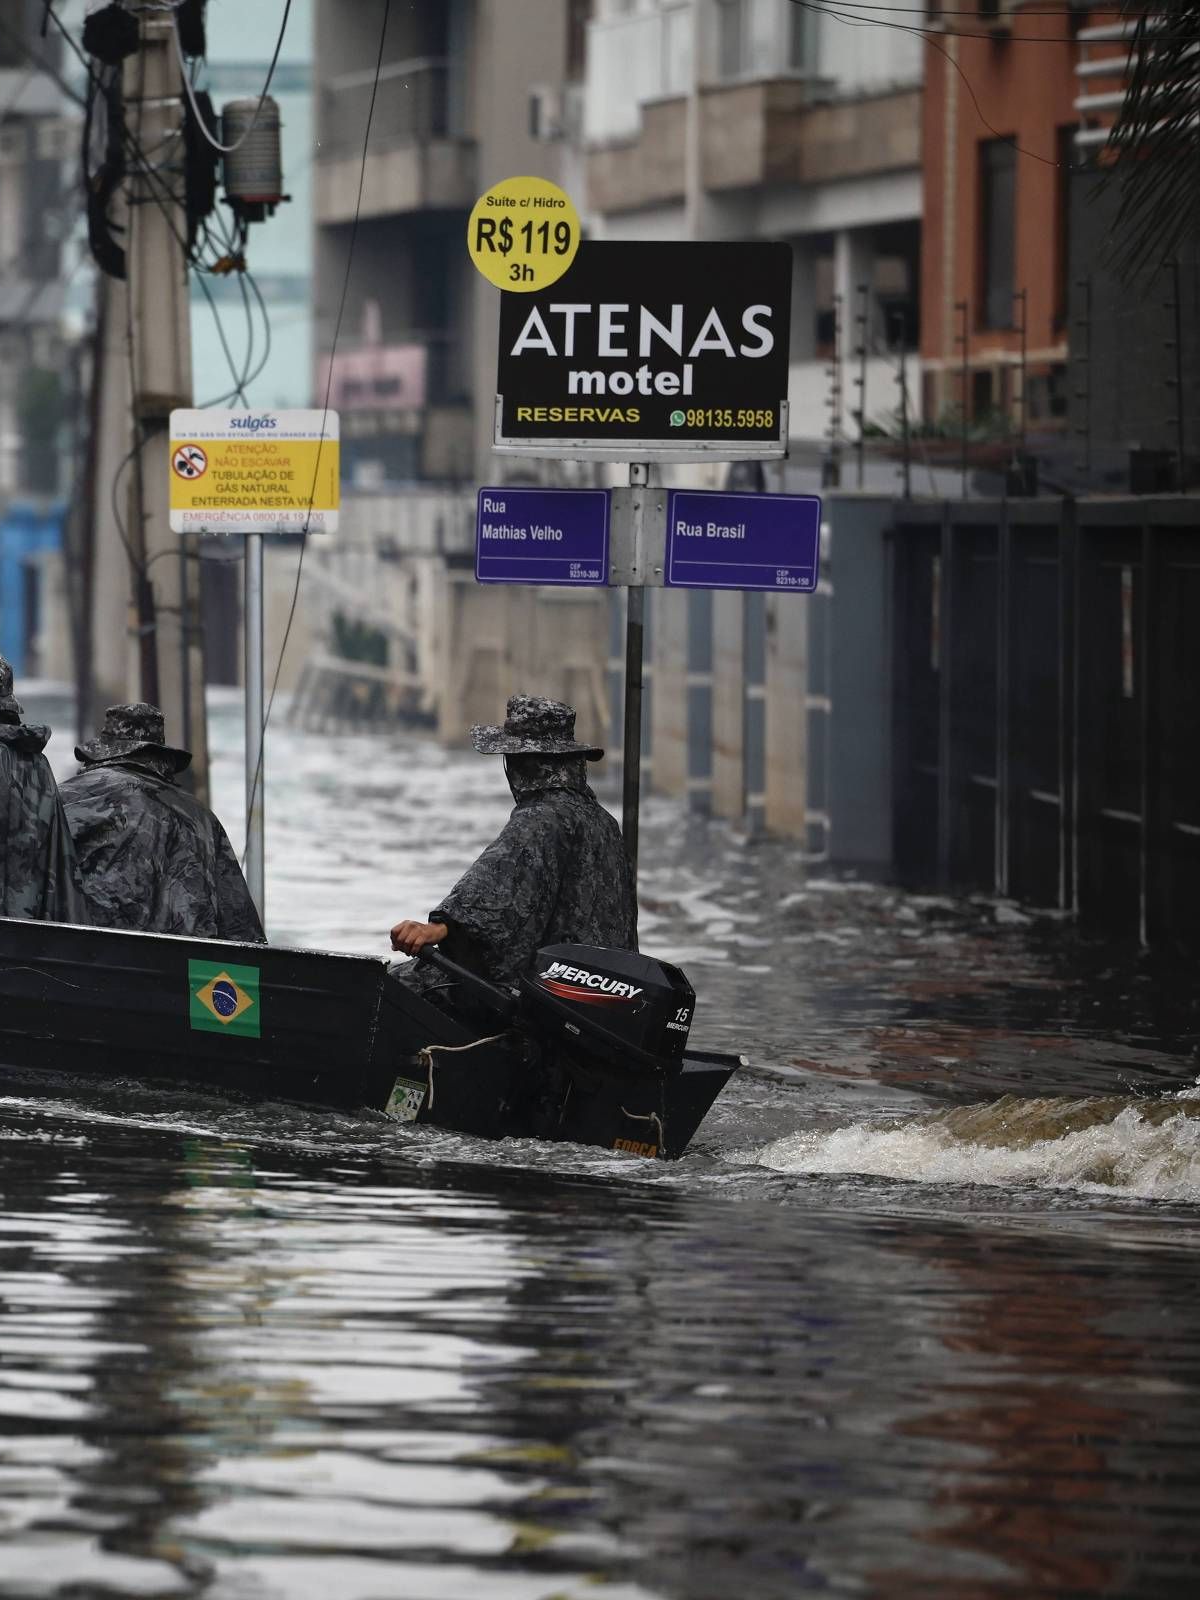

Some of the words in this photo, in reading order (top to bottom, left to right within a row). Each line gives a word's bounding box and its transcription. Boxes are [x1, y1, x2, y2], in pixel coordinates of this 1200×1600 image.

[520, 197, 531, 208] c/
[533, 198, 566, 209] Hidro
[476, 216, 514, 257] R$
[521, 220, 571, 255] 119
[509, 263, 534, 281] 3h
[510, 303, 775, 358] ATENAS
[568, 363, 693, 395] motel
[517, 407, 641, 423] RESERVAS
[686, 409, 774, 428] 98135.5958
[215, 457, 239, 467] NÃO
[241, 457, 291, 467] ESCAVAR
[211, 470, 277, 482] TUBULAÇÃO
[280, 471, 295, 480] DE
[216, 483, 239, 493] GÁS
[241, 484, 290, 493] NATURAL
[192, 497, 258, 506] ENTERRADA
[260, 497, 294, 506] NESTA
[483, 498, 506, 513] Rua
[183, 511, 251, 522] EMERGÊNCIA
[253, 512, 276, 522] 0800
[482, 524, 527, 539] Mathias
[530, 525, 563, 540] Velho
[676, 521, 703, 537] Rua
[707, 522, 745, 539] Brasil
[539, 961, 644, 999] MERCURY
[674, 1007, 690, 1023] 15
